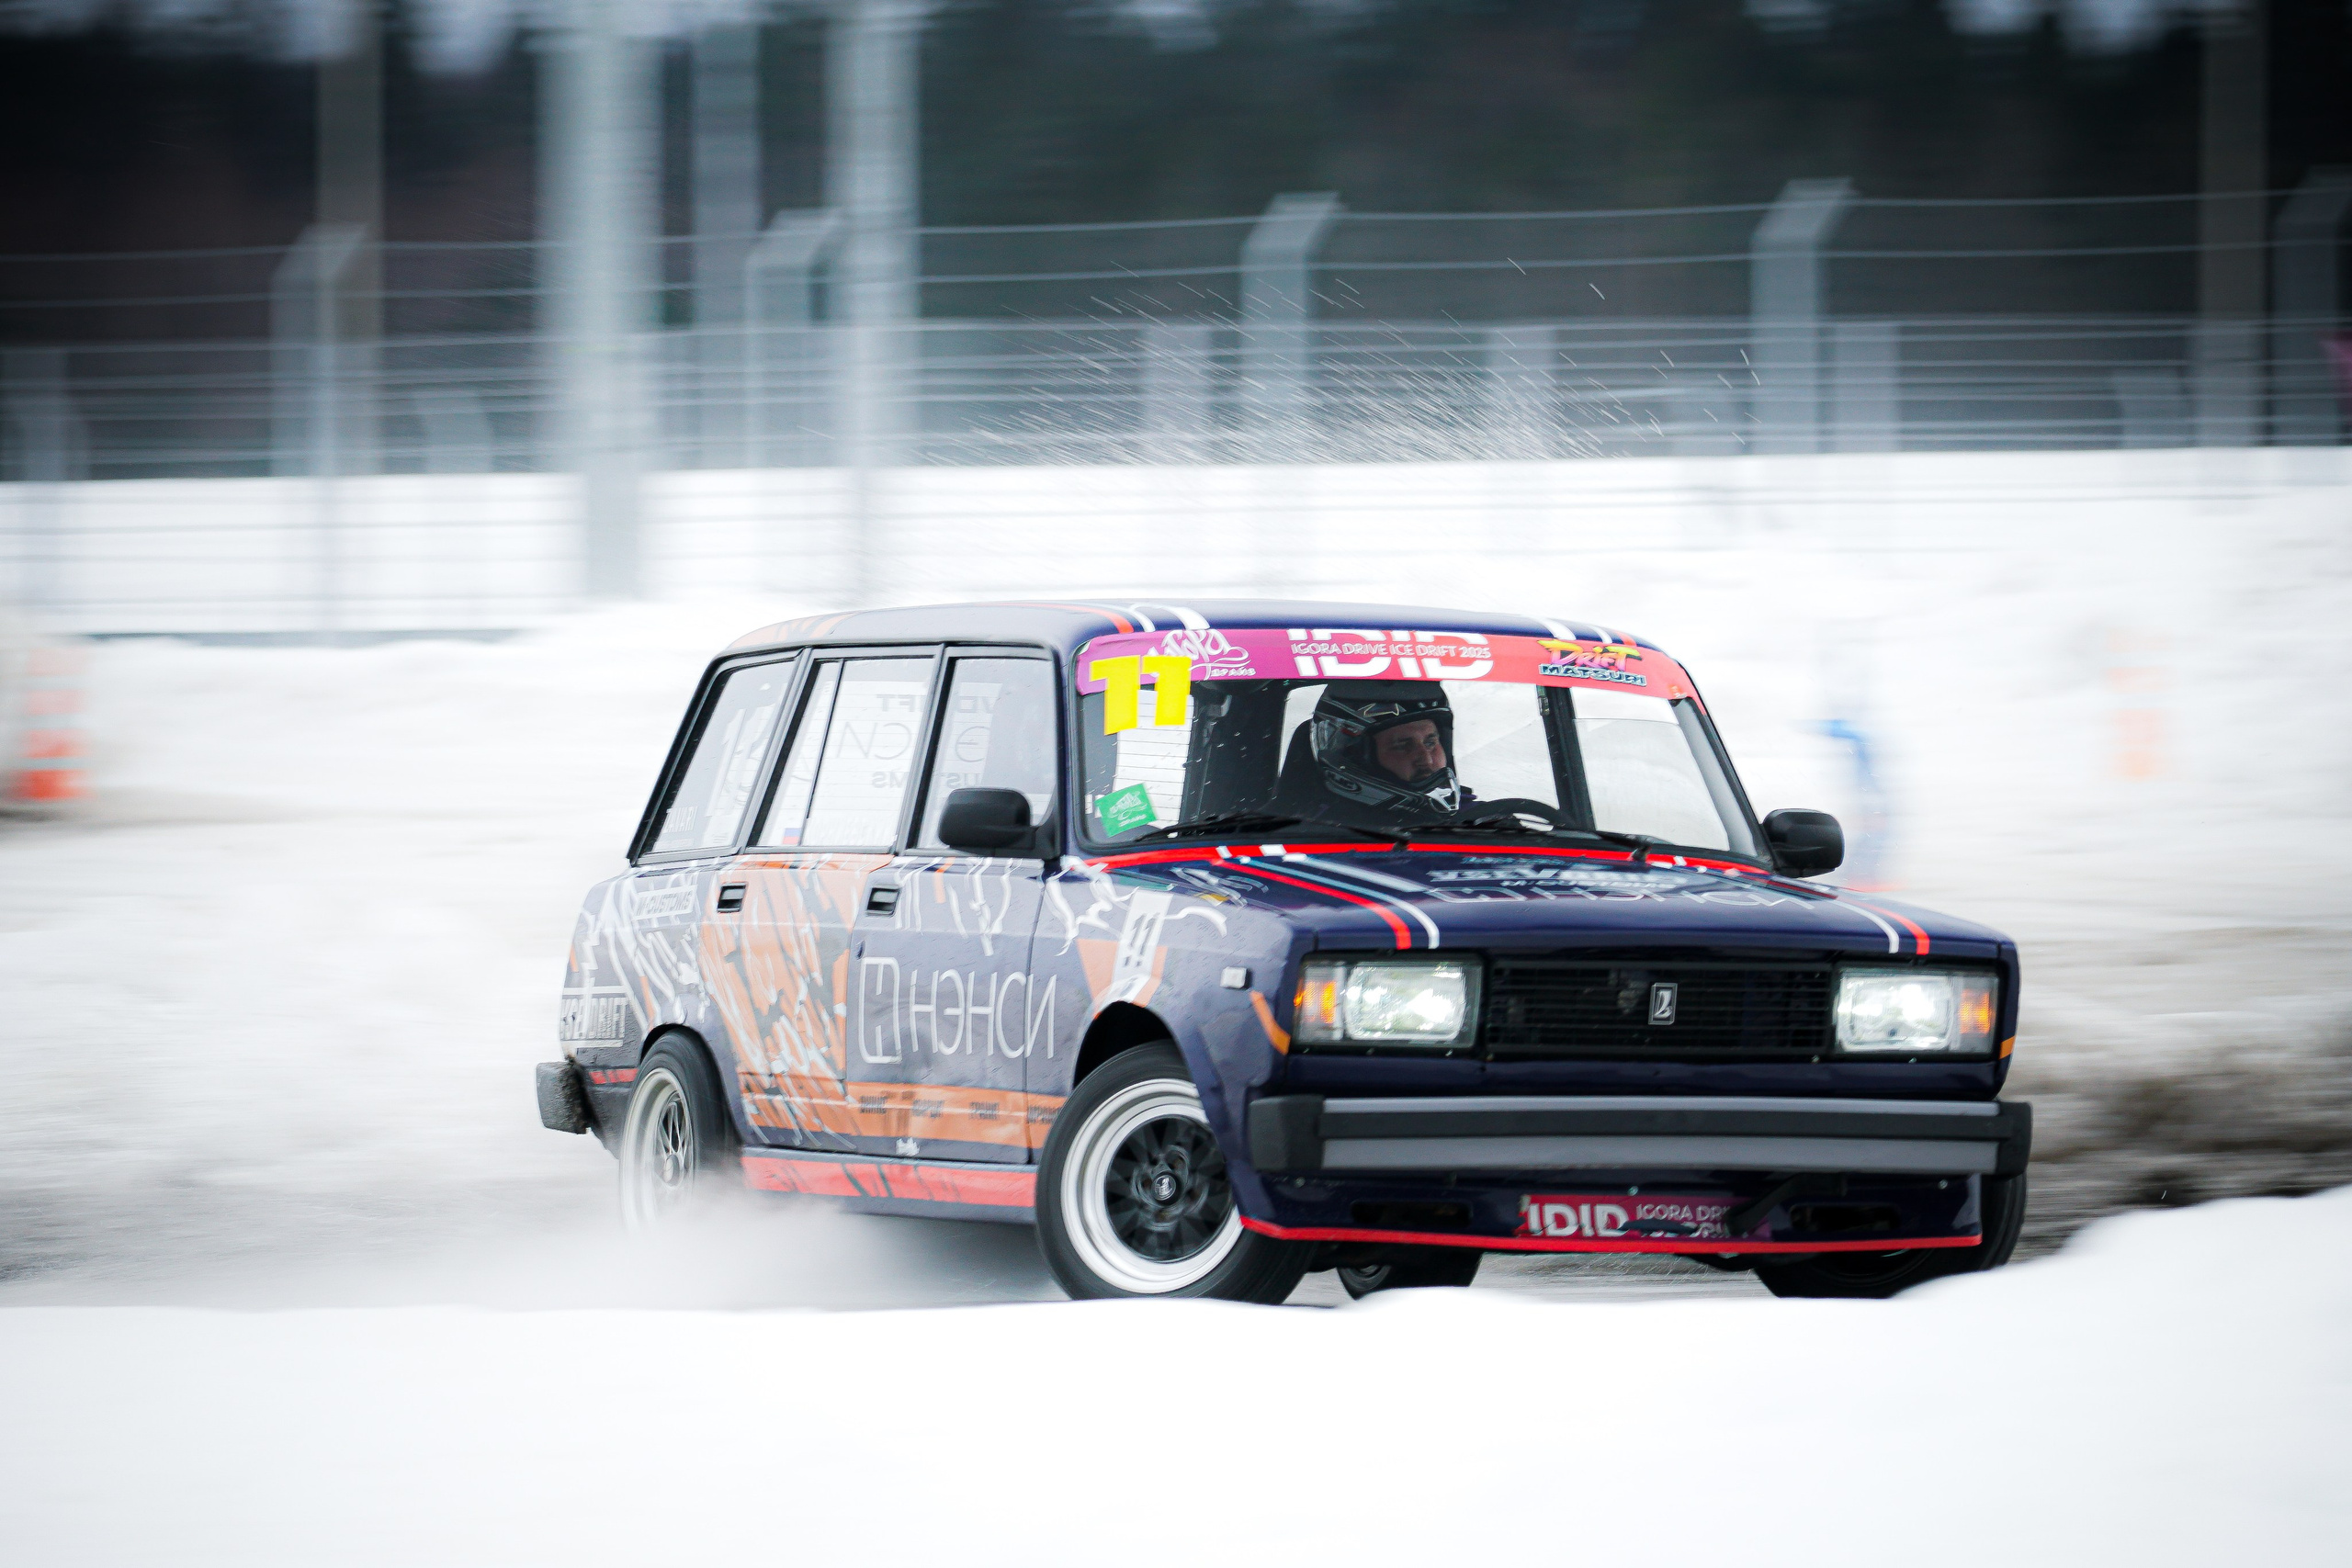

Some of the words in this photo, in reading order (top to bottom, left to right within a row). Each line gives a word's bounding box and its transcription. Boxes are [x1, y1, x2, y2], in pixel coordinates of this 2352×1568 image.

[1291, 643, 1341, 655] IGORA
[1342, 644, 1388, 656] DRIVE
[1389, 644, 1415, 656] ICE
[1416, 645, 1457, 658] DRIFT
[1459, 646, 1492, 659] 2025
[1538, 663, 1647, 687] MATSURI
[1090, 654, 1193, 736] 11
[909, 968, 1057, 1060] НЭНСИ
[1527, 1203, 1629, 1237] IDID
